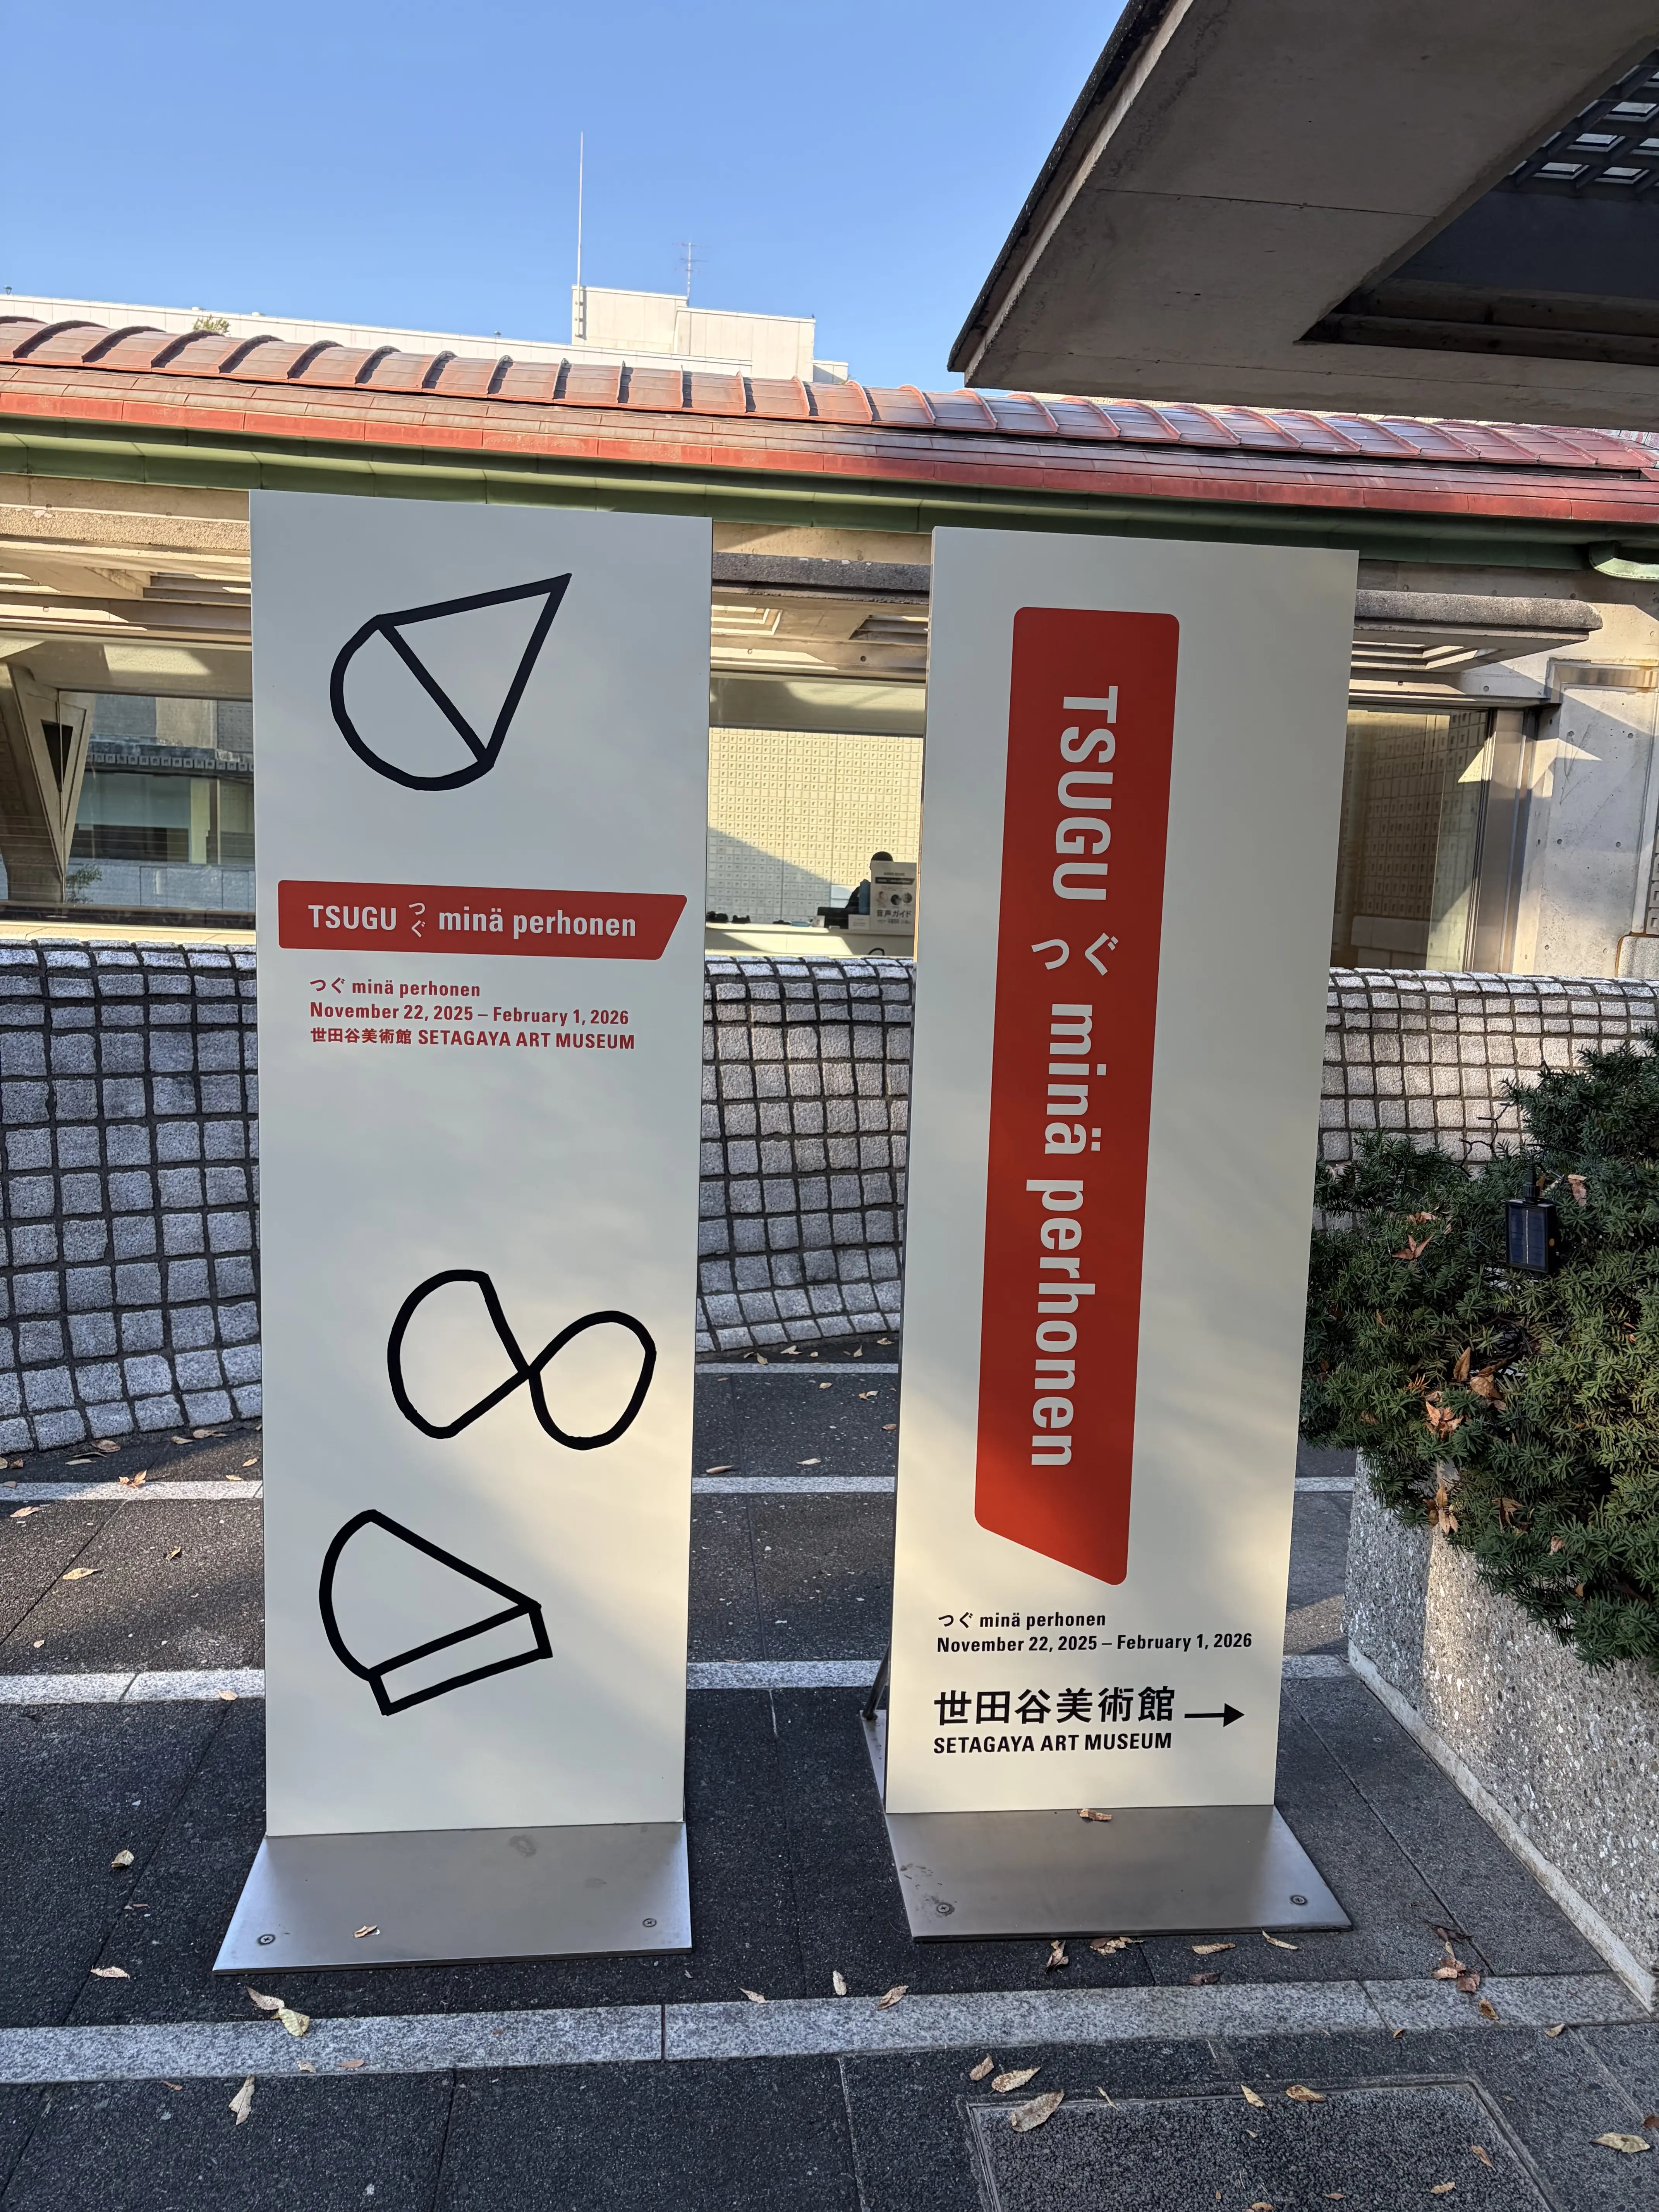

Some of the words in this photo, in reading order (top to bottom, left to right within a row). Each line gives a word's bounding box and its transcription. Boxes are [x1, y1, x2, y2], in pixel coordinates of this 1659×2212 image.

[1053, 686, 1118, 900] TSUGU
[308, 905, 396, 930] TSUGU
[440, 907, 503, 931] minä
[514, 910, 635, 939] perhonen
[310, 977, 345, 993] つぐ
[352, 979, 393, 994] minä
[400, 981, 480, 998] perhonen
[310, 1002, 399, 1018] November
[404, 1005, 428, 1022] 22,
[433, 1006, 472, 1020] 2025
[493, 1006, 568, 1026] February
[574, 1009, 586, 1025] 1,
[591, 1010, 628, 1024] 2026
[311, 1027, 411, 1044] 世田谷美術館
[418, 1030, 510, 1046] SETAGAYA
[516, 1032, 550, 1047] ART
[556, 1034, 634, 1049] MUSEUM
[1045, 1004, 1106, 1154] minä
[1026, 1180, 1095, 1465] perhonen
[938, 1612, 973, 1628] つぐ
[980, 1613, 1020, 1627] minä
[1027, 1611, 1106, 1630] perhonen
[938, 1637, 1024, 1652] November
[1029, 1637, 1053, 1652] 22,
[1058, 1635, 1097, 1650] 2025
[1117, 1635, 1192, 1652] February
[1197, 1634, 1209, 1650] 1,
[1213, 1633, 1252, 1648] 2026
[934, 1685, 1175, 1726] 世田谷美術館
[934, 1736, 1034, 1753] SETAGAYA
[1040, 1735, 1079, 1751] ART
[1085, 1732, 1171, 1750] MUSEUM
